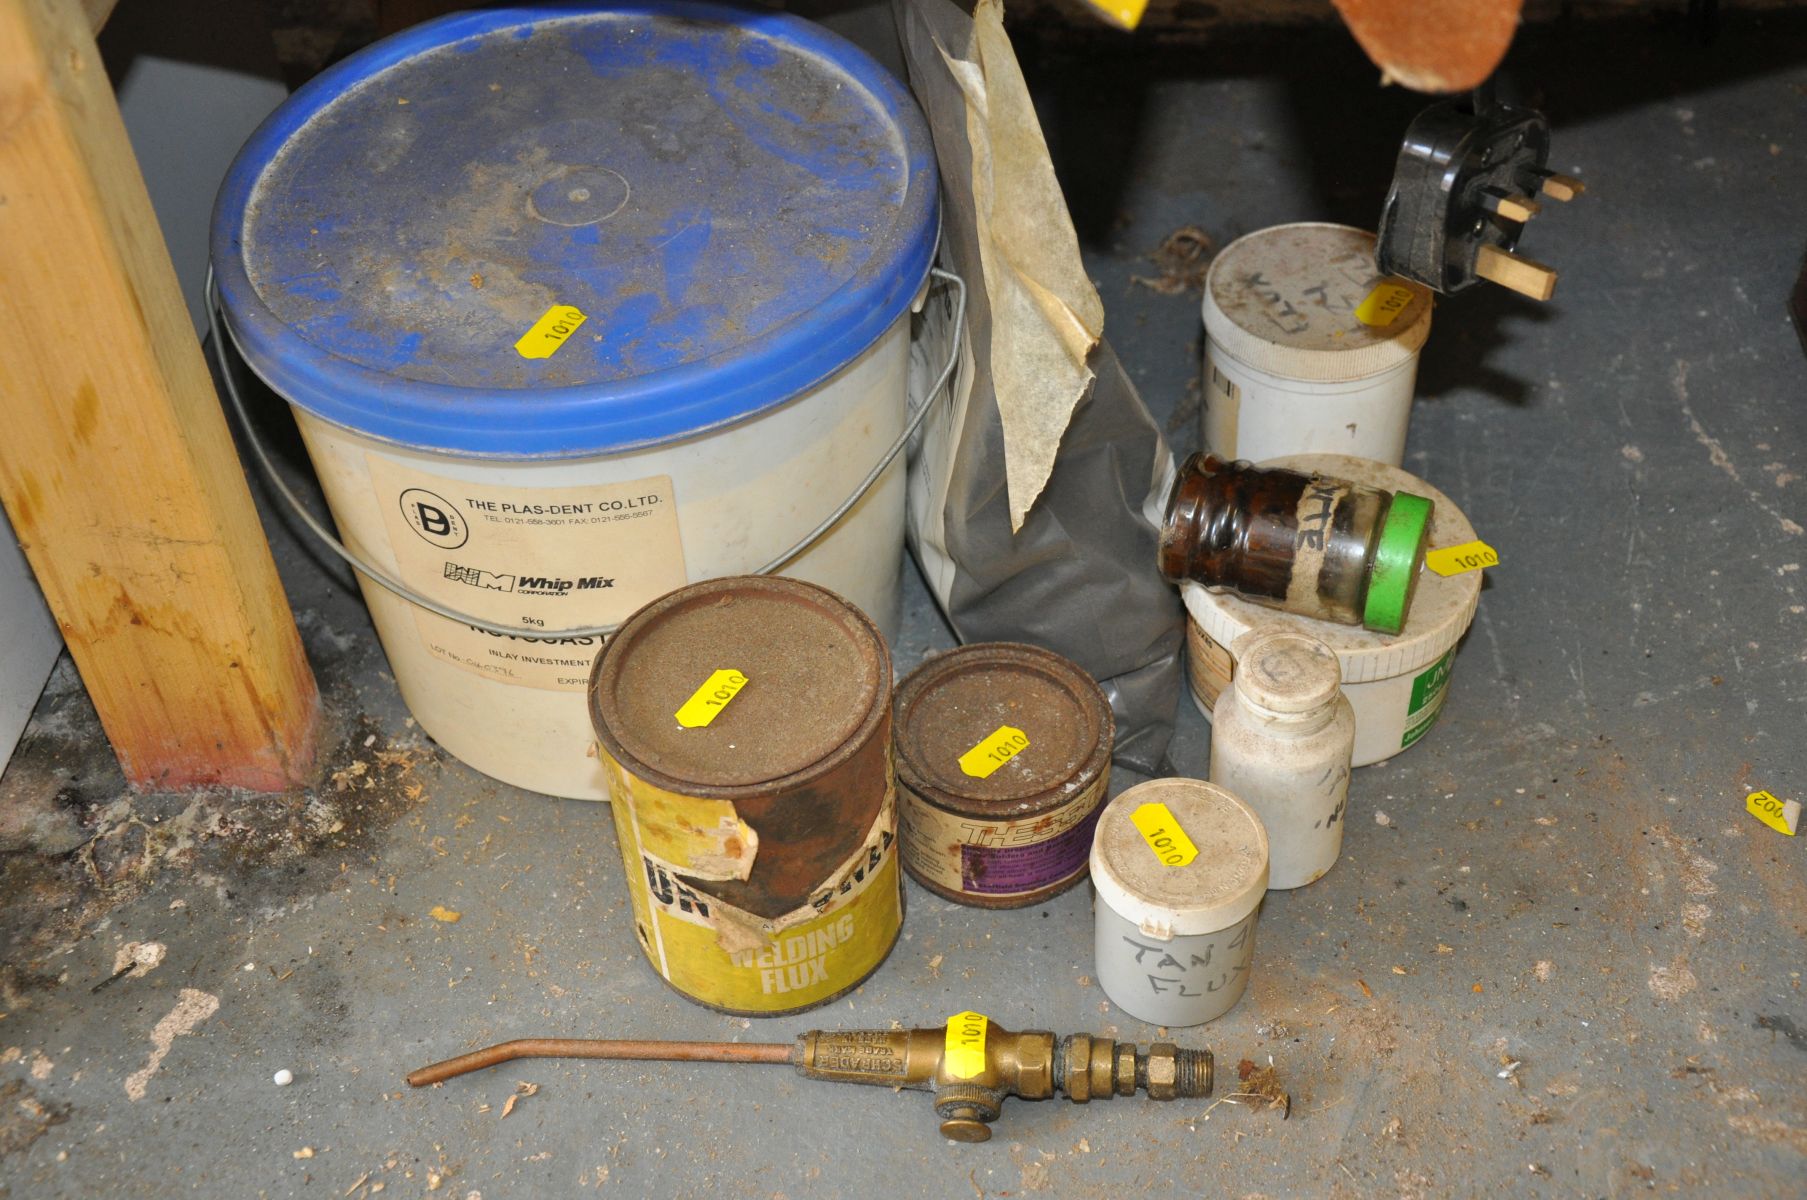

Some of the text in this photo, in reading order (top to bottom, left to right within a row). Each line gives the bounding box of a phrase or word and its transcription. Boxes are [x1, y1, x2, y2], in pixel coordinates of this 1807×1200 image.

[1380, 289, 1412, 314] 1010
[544, 311, 582, 341] 1010
[466, 494, 663, 516] THE PLAS-DENT CO.LTD.
[1455, 551, 1496, 569] 1010
[517, 589, 569, 597] CORPORATION
[519, 576, 616, 592] Whip Mix
[522, 616, 545, 628] 5kg
[488, 648, 591, 668] INLAY INVESTMENT
[705, 675, 745, 706] 1010
[988, 735, 1026, 762] 1010
[1149, 828, 1183, 865] 1010
[730, 913, 855, 968] WELDING
[760, 955, 829, 995] FLUX
[1147, 956, 1248, 996] FLUX
[960, 1013, 983, 1046] 1010
[815, 1055, 903, 1072] SCHRADER
